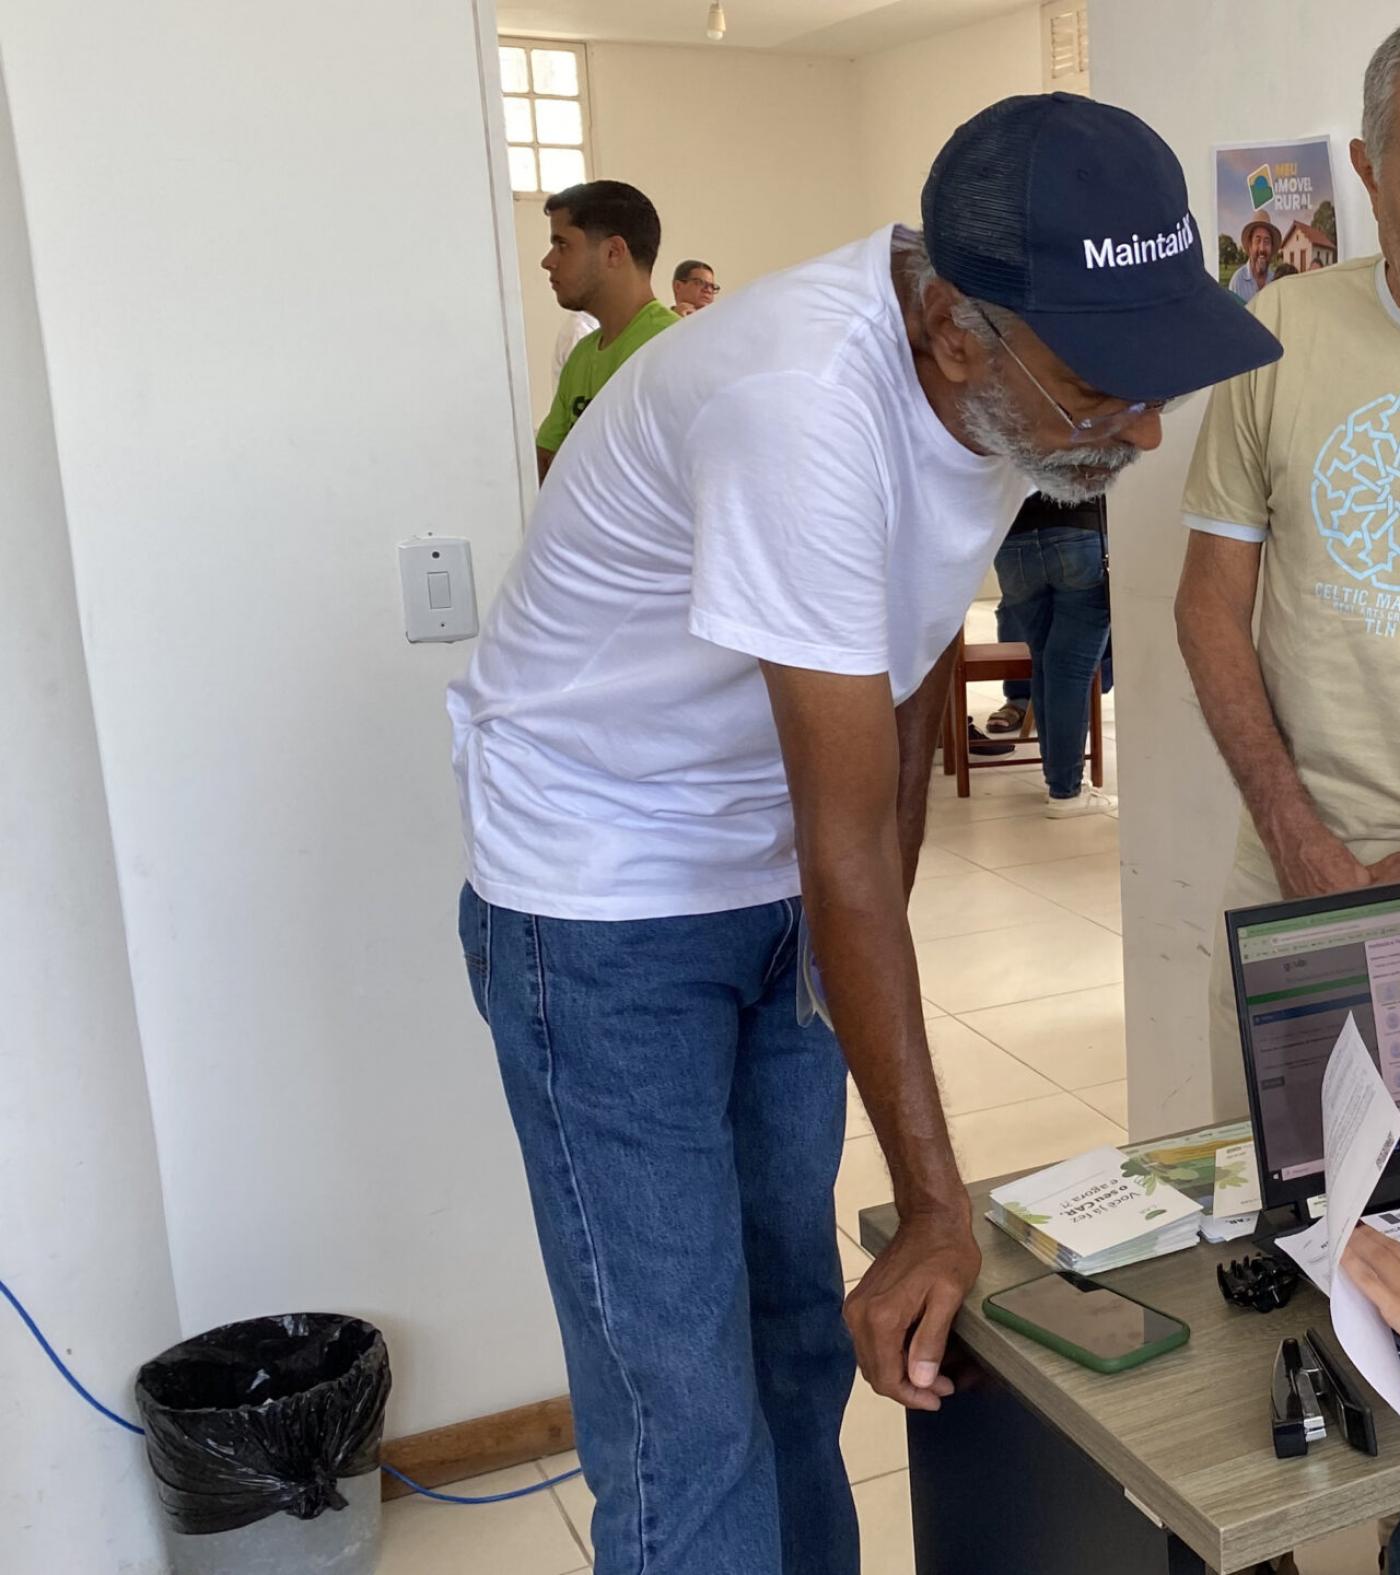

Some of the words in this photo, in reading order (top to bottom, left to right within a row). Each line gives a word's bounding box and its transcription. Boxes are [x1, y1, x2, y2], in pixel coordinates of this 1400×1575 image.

[1274, 193, 1313, 211] RURAL
[1314, 582, 1369, 606] CELTIC
[1071, 1185, 1109, 1203] agora
[1094, 1190, 1119, 1203] seu
[1107, 1191, 1141, 1208] Você
[1070, 1212, 1093, 1224] fez
[1092, 1205, 1108, 1215] já
